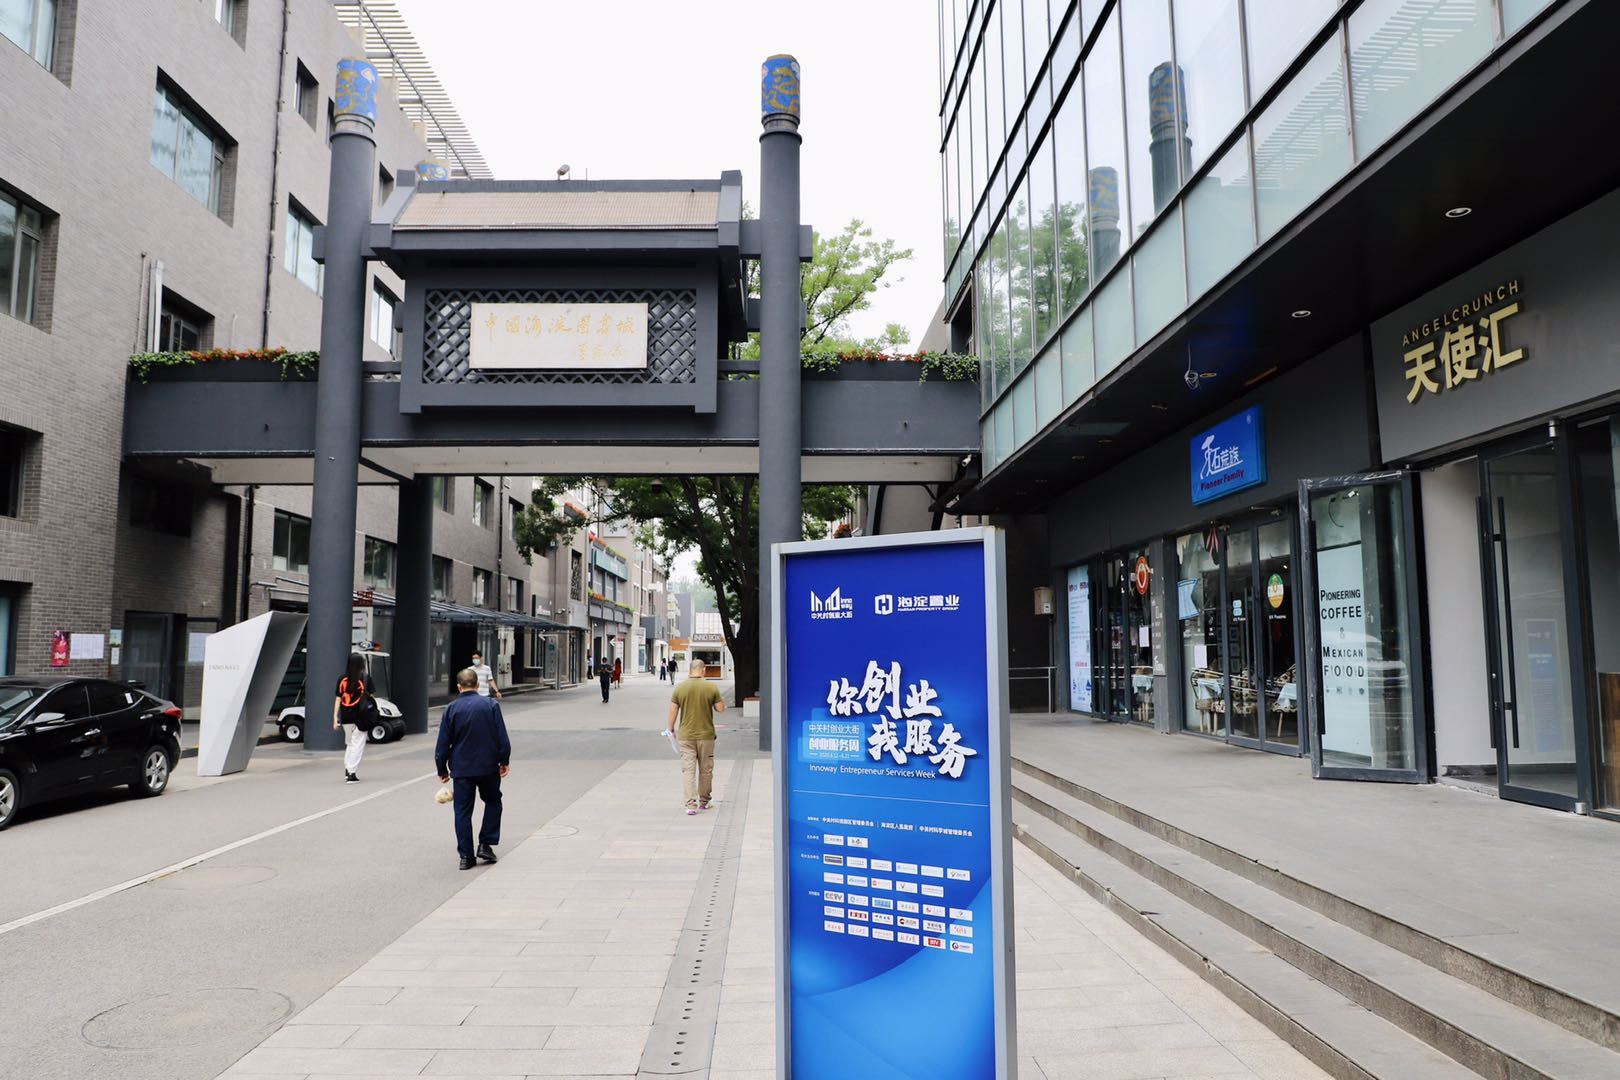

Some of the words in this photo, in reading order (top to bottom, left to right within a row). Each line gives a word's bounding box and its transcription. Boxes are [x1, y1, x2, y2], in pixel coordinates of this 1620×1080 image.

[1403, 280, 1518, 346] ANGELCRUNCH
[1404, 302, 1523, 403] 天使汇
[1201, 478, 1223, 490] Pioneer
[1224, 469, 1244, 483] Family
[1320, 589, 1361, 601] PIONEERING
[1321, 606, 1362, 620] COFFEE
[1323, 646, 1363, 658] MEXICAN
[1324, 665, 1364, 677] FOOD
[827, 660, 942, 720] 你创业
[808, 724, 860, 735] 中关村创业大街
[809, 737, 860, 752] 创业服务周
[867, 715, 977, 778] 我服务
[809, 764, 837, 775] Innoway
[840, 765, 885, 777] Entrepreneur
[885, 768, 915, 778] Services
[915, 770, 936, 779] Week
